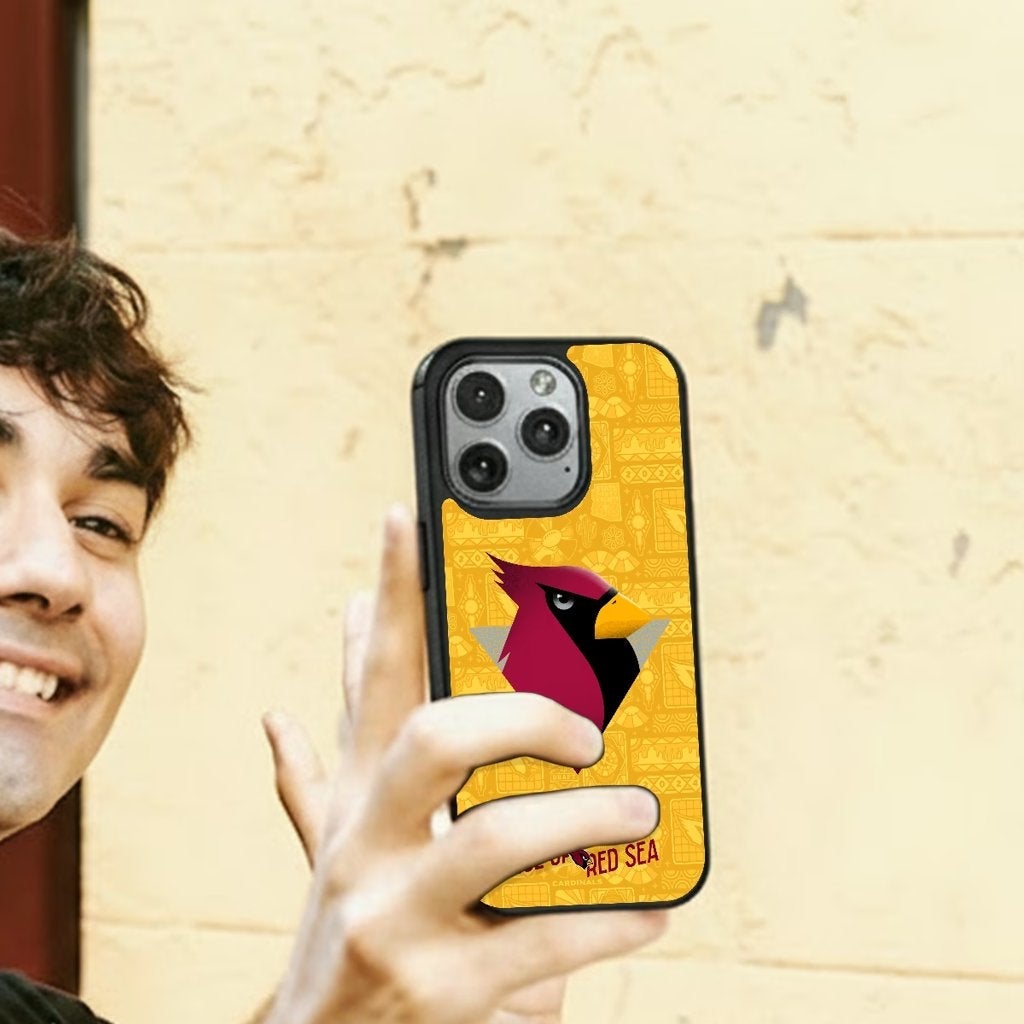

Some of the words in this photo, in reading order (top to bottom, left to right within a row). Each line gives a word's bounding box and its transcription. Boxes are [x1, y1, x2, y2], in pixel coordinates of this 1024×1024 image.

[587, 848, 618, 877] RED
[625, 839, 659, 867] SEA
[553, 879, 603, 887] CARDINALS
